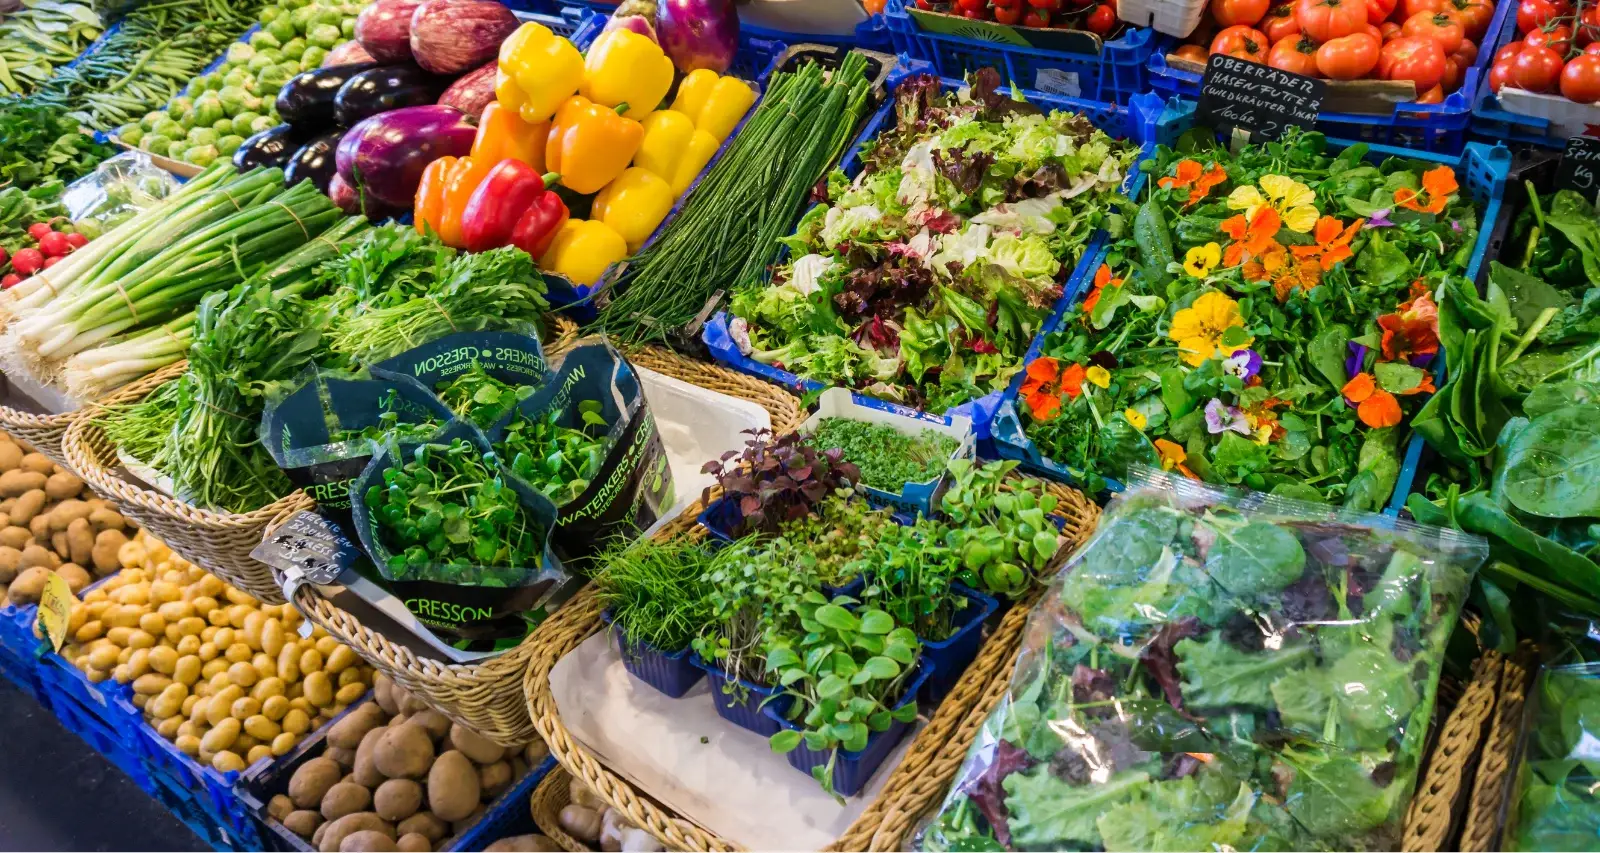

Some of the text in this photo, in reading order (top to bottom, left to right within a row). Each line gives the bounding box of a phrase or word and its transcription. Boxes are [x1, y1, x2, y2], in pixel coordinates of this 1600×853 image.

[1213, 56, 1314, 94] OBERRÄDER
[555, 456, 630, 527] WATERKERS
[404, 598, 493, 623] CRESSON
